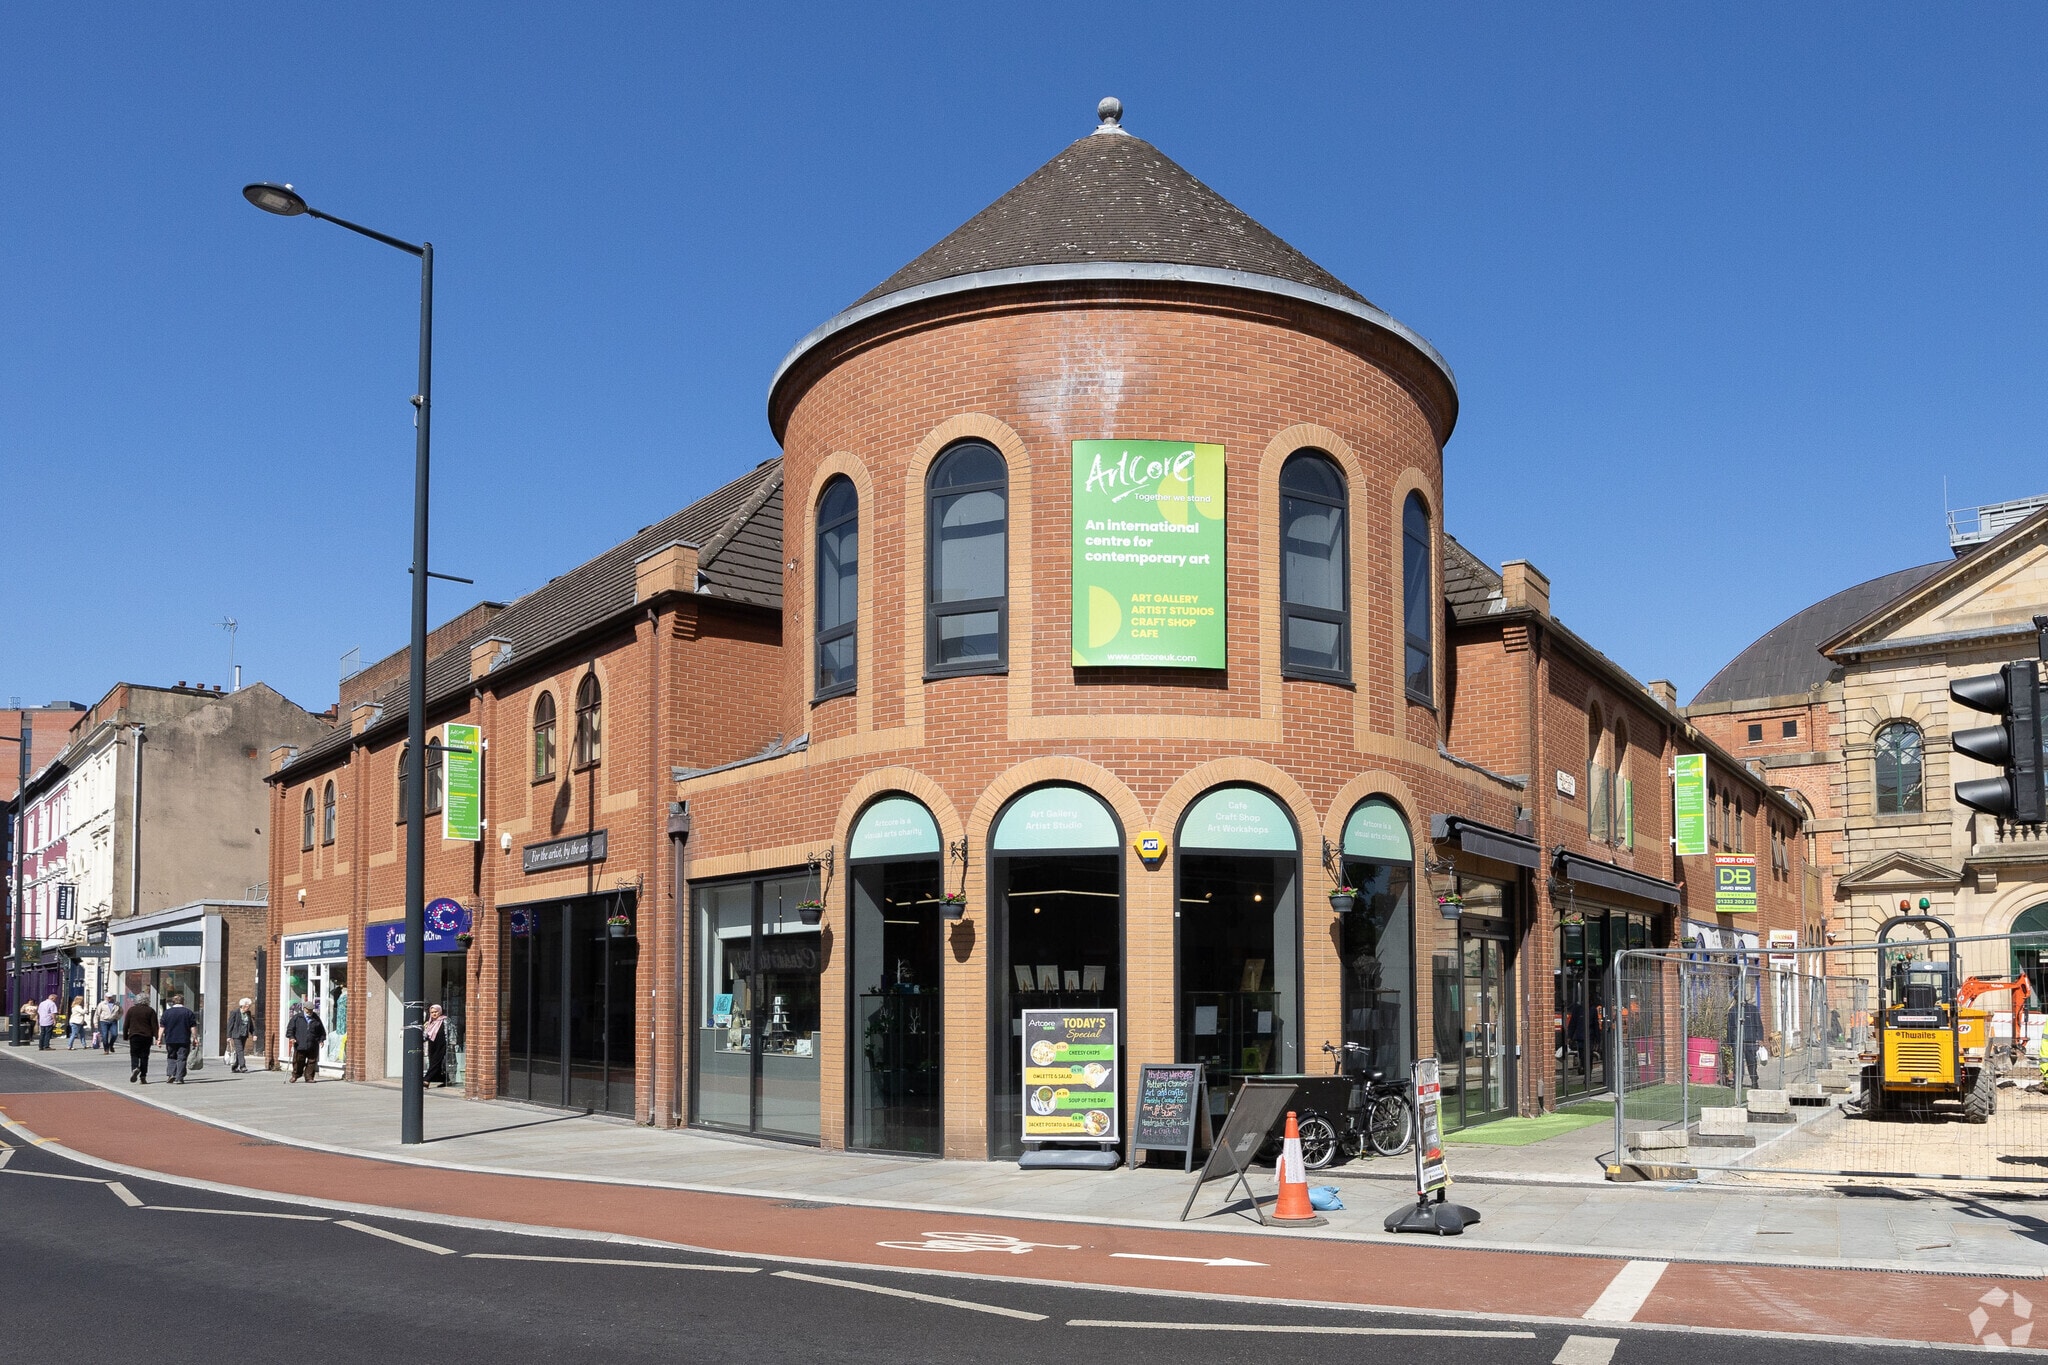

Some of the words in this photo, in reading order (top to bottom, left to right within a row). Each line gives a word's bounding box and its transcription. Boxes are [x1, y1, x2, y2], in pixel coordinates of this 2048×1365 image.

[1135, 492, 1171, 503] Together
[1187, 495, 1211, 503] stand
[1085, 519, 1105, 530] An
[1107, 519, 1199, 534] international
[1085, 537, 1131, 548] centre
[1133, 536, 1153, 548] for
[1085, 552, 1187, 567] contemporary
[1189, 554, 1210, 565] art
[1131, 594, 1152, 603] ART
[1154, 594, 1199, 604] GALLERY
[1131, 605, 1168, 615] ARTIST
[1169, 606, 1215, 616] STUDIOS
[1131, 617, 1165, 627] CRAFT
[1167, 618, 1196, 627] SHOP
[1131, 629, 1159, 638] CAFE
[1107, 652, 1197, 663] www.artcoreuk.com
[1228, 801, 1248, 810] Cafe
[1030, 809, 1044, 818] Art
[1046, 809, 1078, 820] Gallery
[1215, 812, 1238, 821] Craft
[1239, 812, 1261, 823] Shop
[1025, 820, 1051, 830] Artist
[1053, 820, 1082, 830] Studio
[1207, 824, 1221, 832] Art
[1222, 824, 1269, 835] Workshops
[883, 830, 897, 839] arts
[898, 827, 922, 836] charity
[1143, 840, 1158, 849] ADT
[531, 850, 541, 863] For
[540, 849, 548, 861] the
[548, 846, 563, 860] artist,
[563, 843, 570, 860] by
[571, 841, 579, 854] the
[1720, 868, 1751, 885] DB
[1028, 1019, 1056, 1028] Artcore
[1063, 1018, 1106, 1029] TODAY'S
[1065, 1029, 1103, 1042] Special
